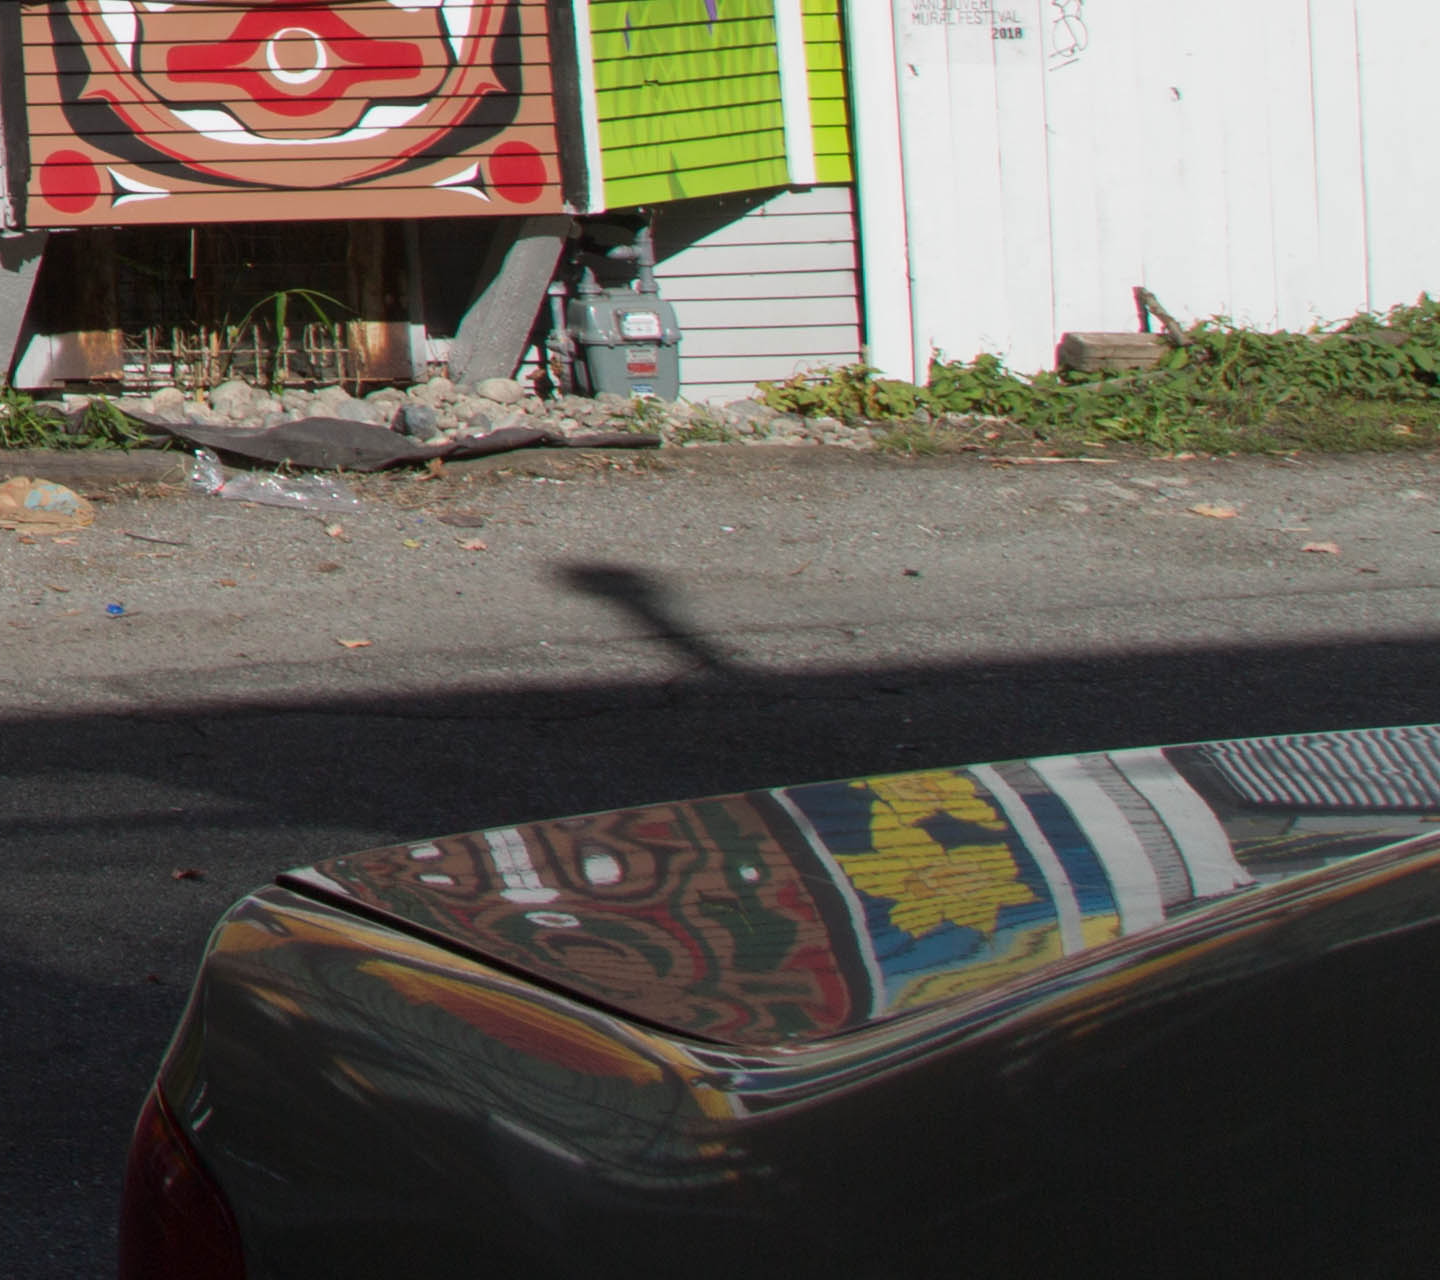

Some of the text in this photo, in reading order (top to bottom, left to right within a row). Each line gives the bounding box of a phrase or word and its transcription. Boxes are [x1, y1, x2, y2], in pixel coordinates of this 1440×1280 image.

[911, 9, 1022, 25] MURAL FESTIVAL
[991, 26, 1024, 40] 2018
